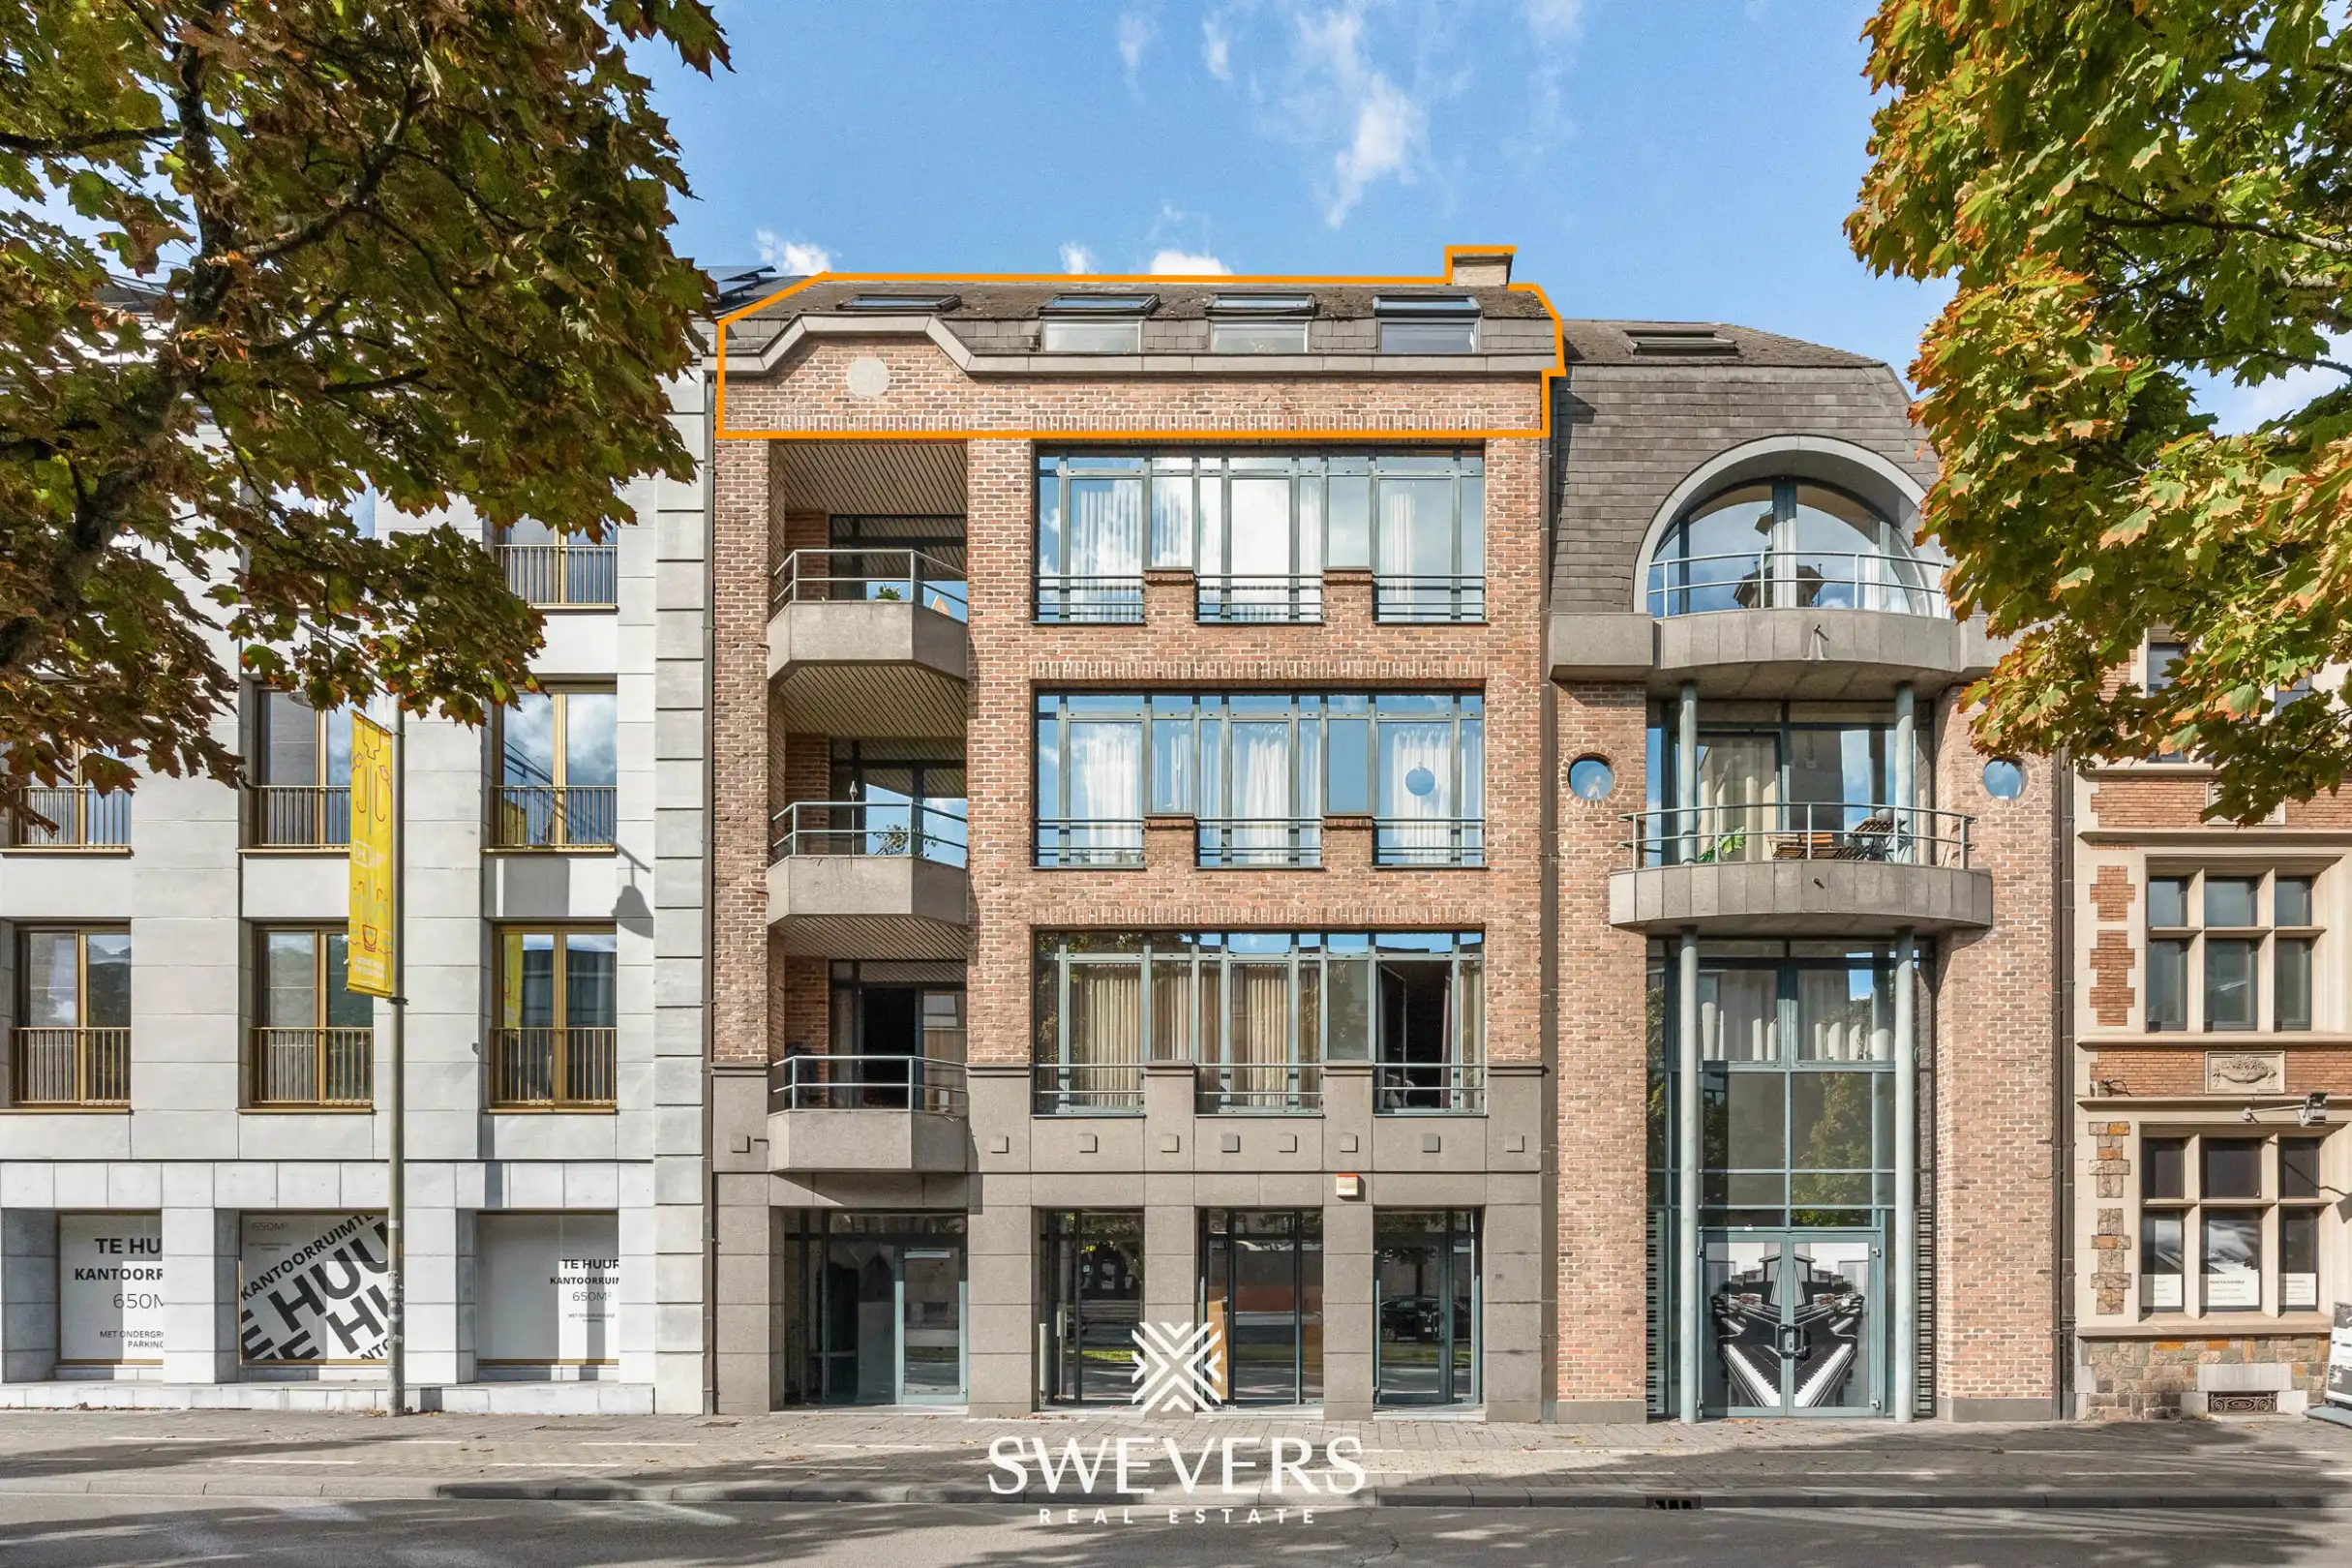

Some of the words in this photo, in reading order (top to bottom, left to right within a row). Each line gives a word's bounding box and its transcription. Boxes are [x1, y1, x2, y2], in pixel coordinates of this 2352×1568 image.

[95, 1238, 123, 1254] TE
[561, 1259, 579, 1269] TE
[119, 1330, 164, 1339] ONDERGR
